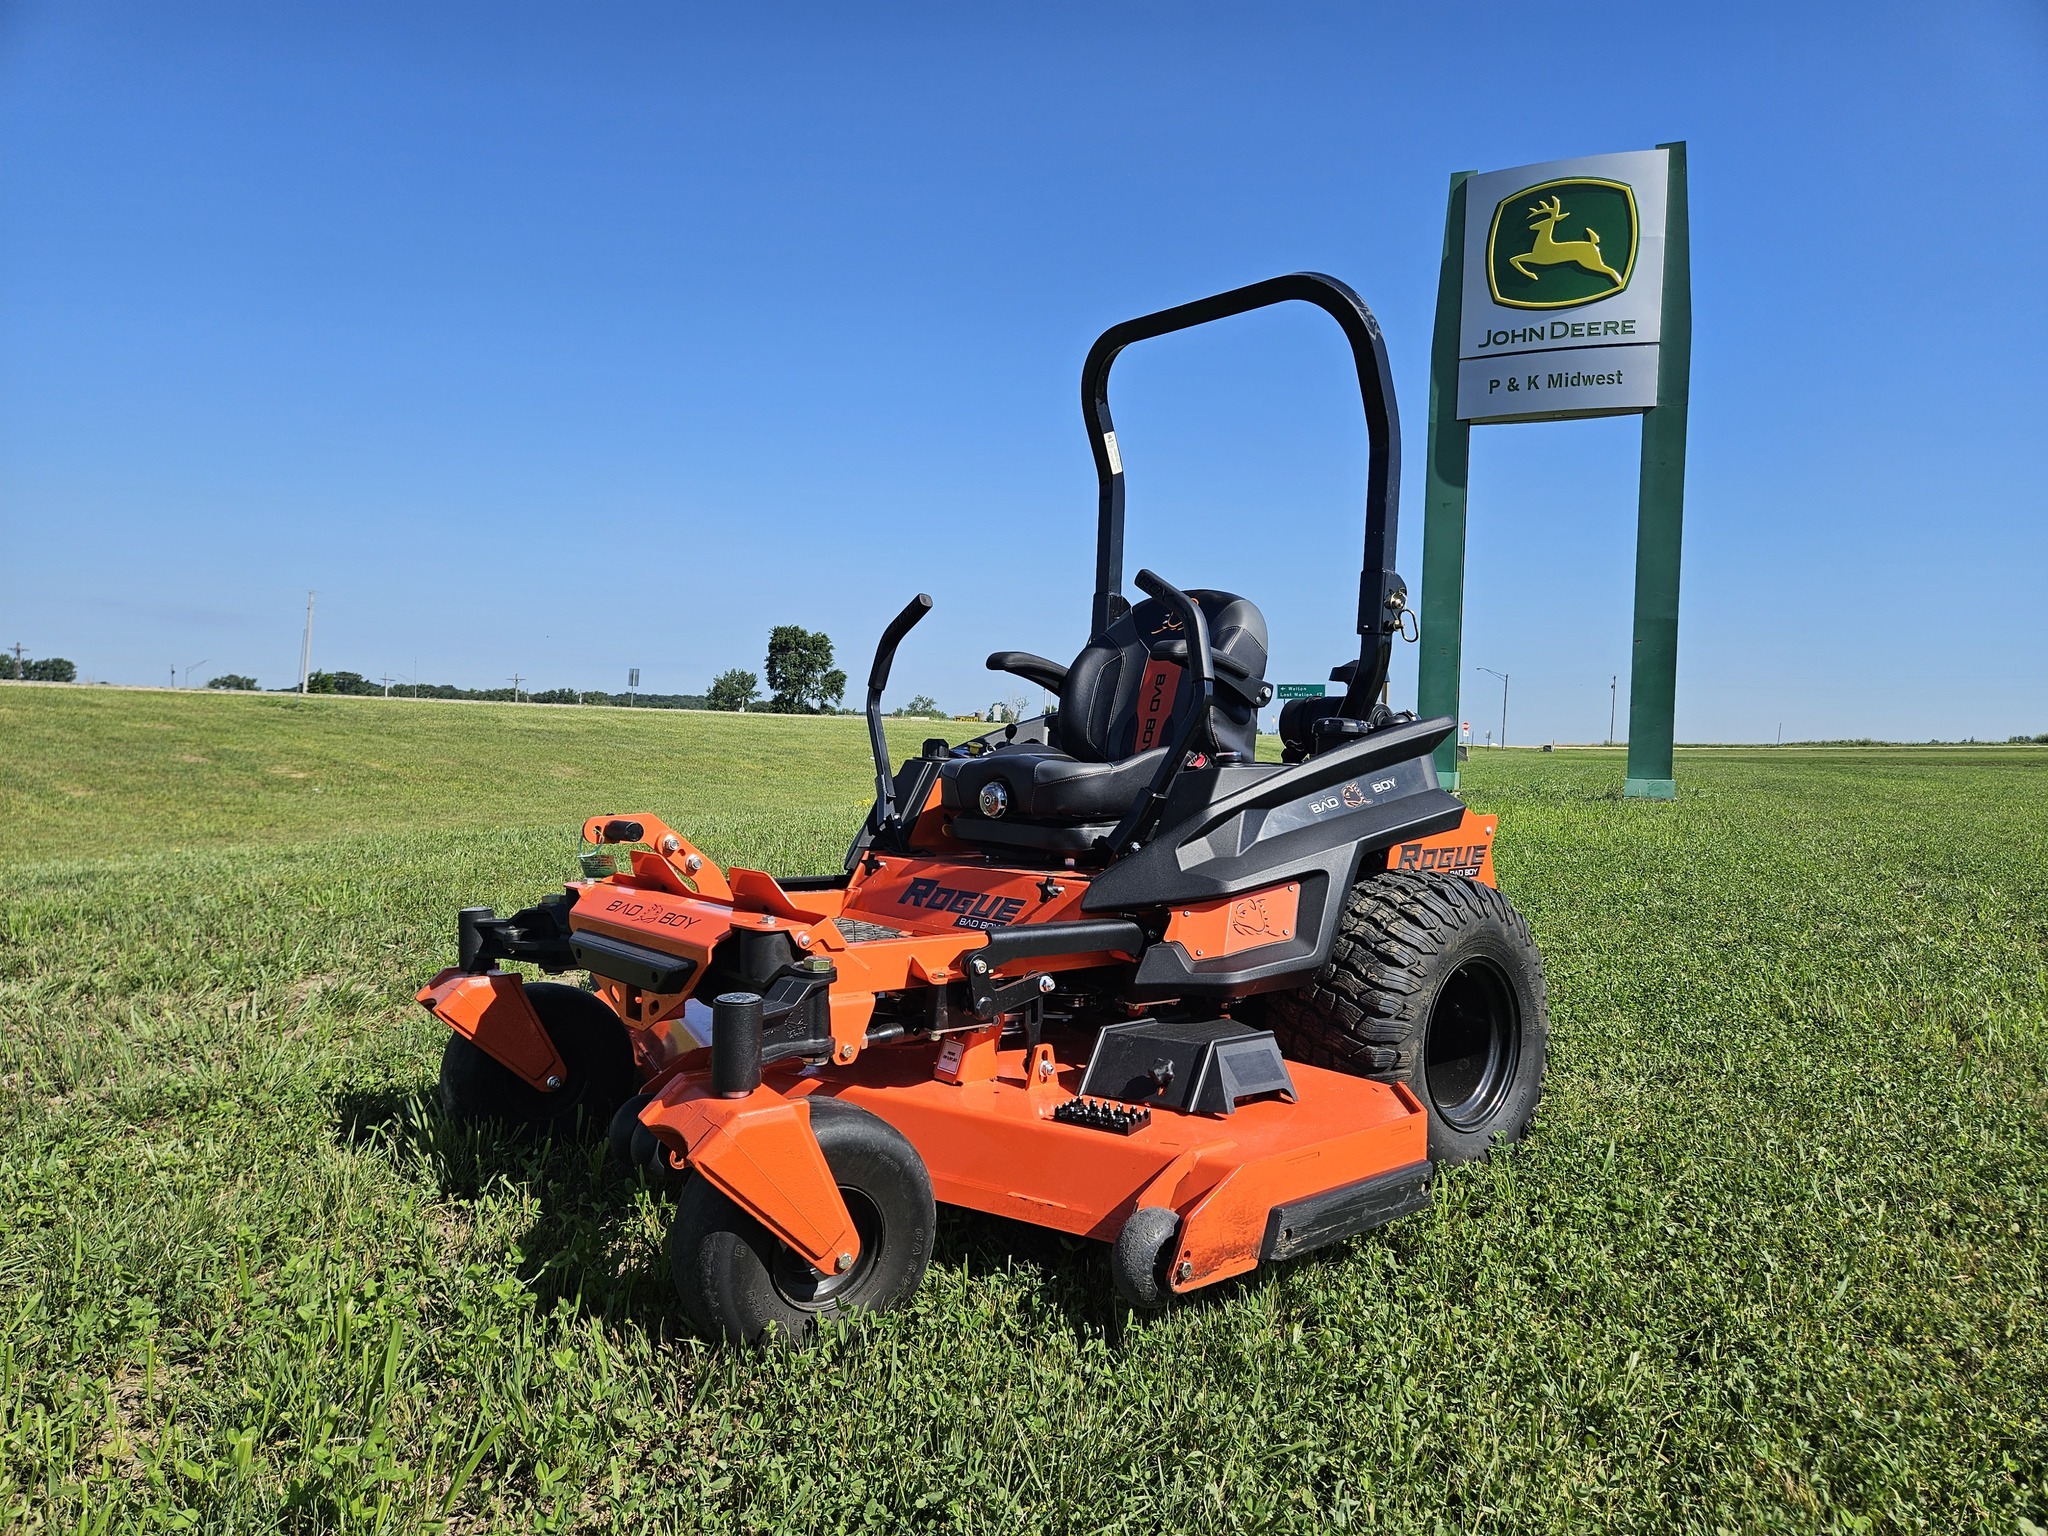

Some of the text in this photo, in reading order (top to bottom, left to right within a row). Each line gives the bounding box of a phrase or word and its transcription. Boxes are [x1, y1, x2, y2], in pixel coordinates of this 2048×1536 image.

[1478, 319, 1636, 348] JOHN DEERE
[1489, 370, 1623, 394] P & K Midwest
[1149, 673, 1166, 712] BAD
[1310, 778, 1396, 814] BAD BOY
[1399, 844, 1487, 869] ROGUE
[1464, 867, 1479, 876] BOY
[898, 877, 1027, 922] ROGUE
[606, 900, 702, 930] BAD BOY
[958, 918, 979, 928] BAD
